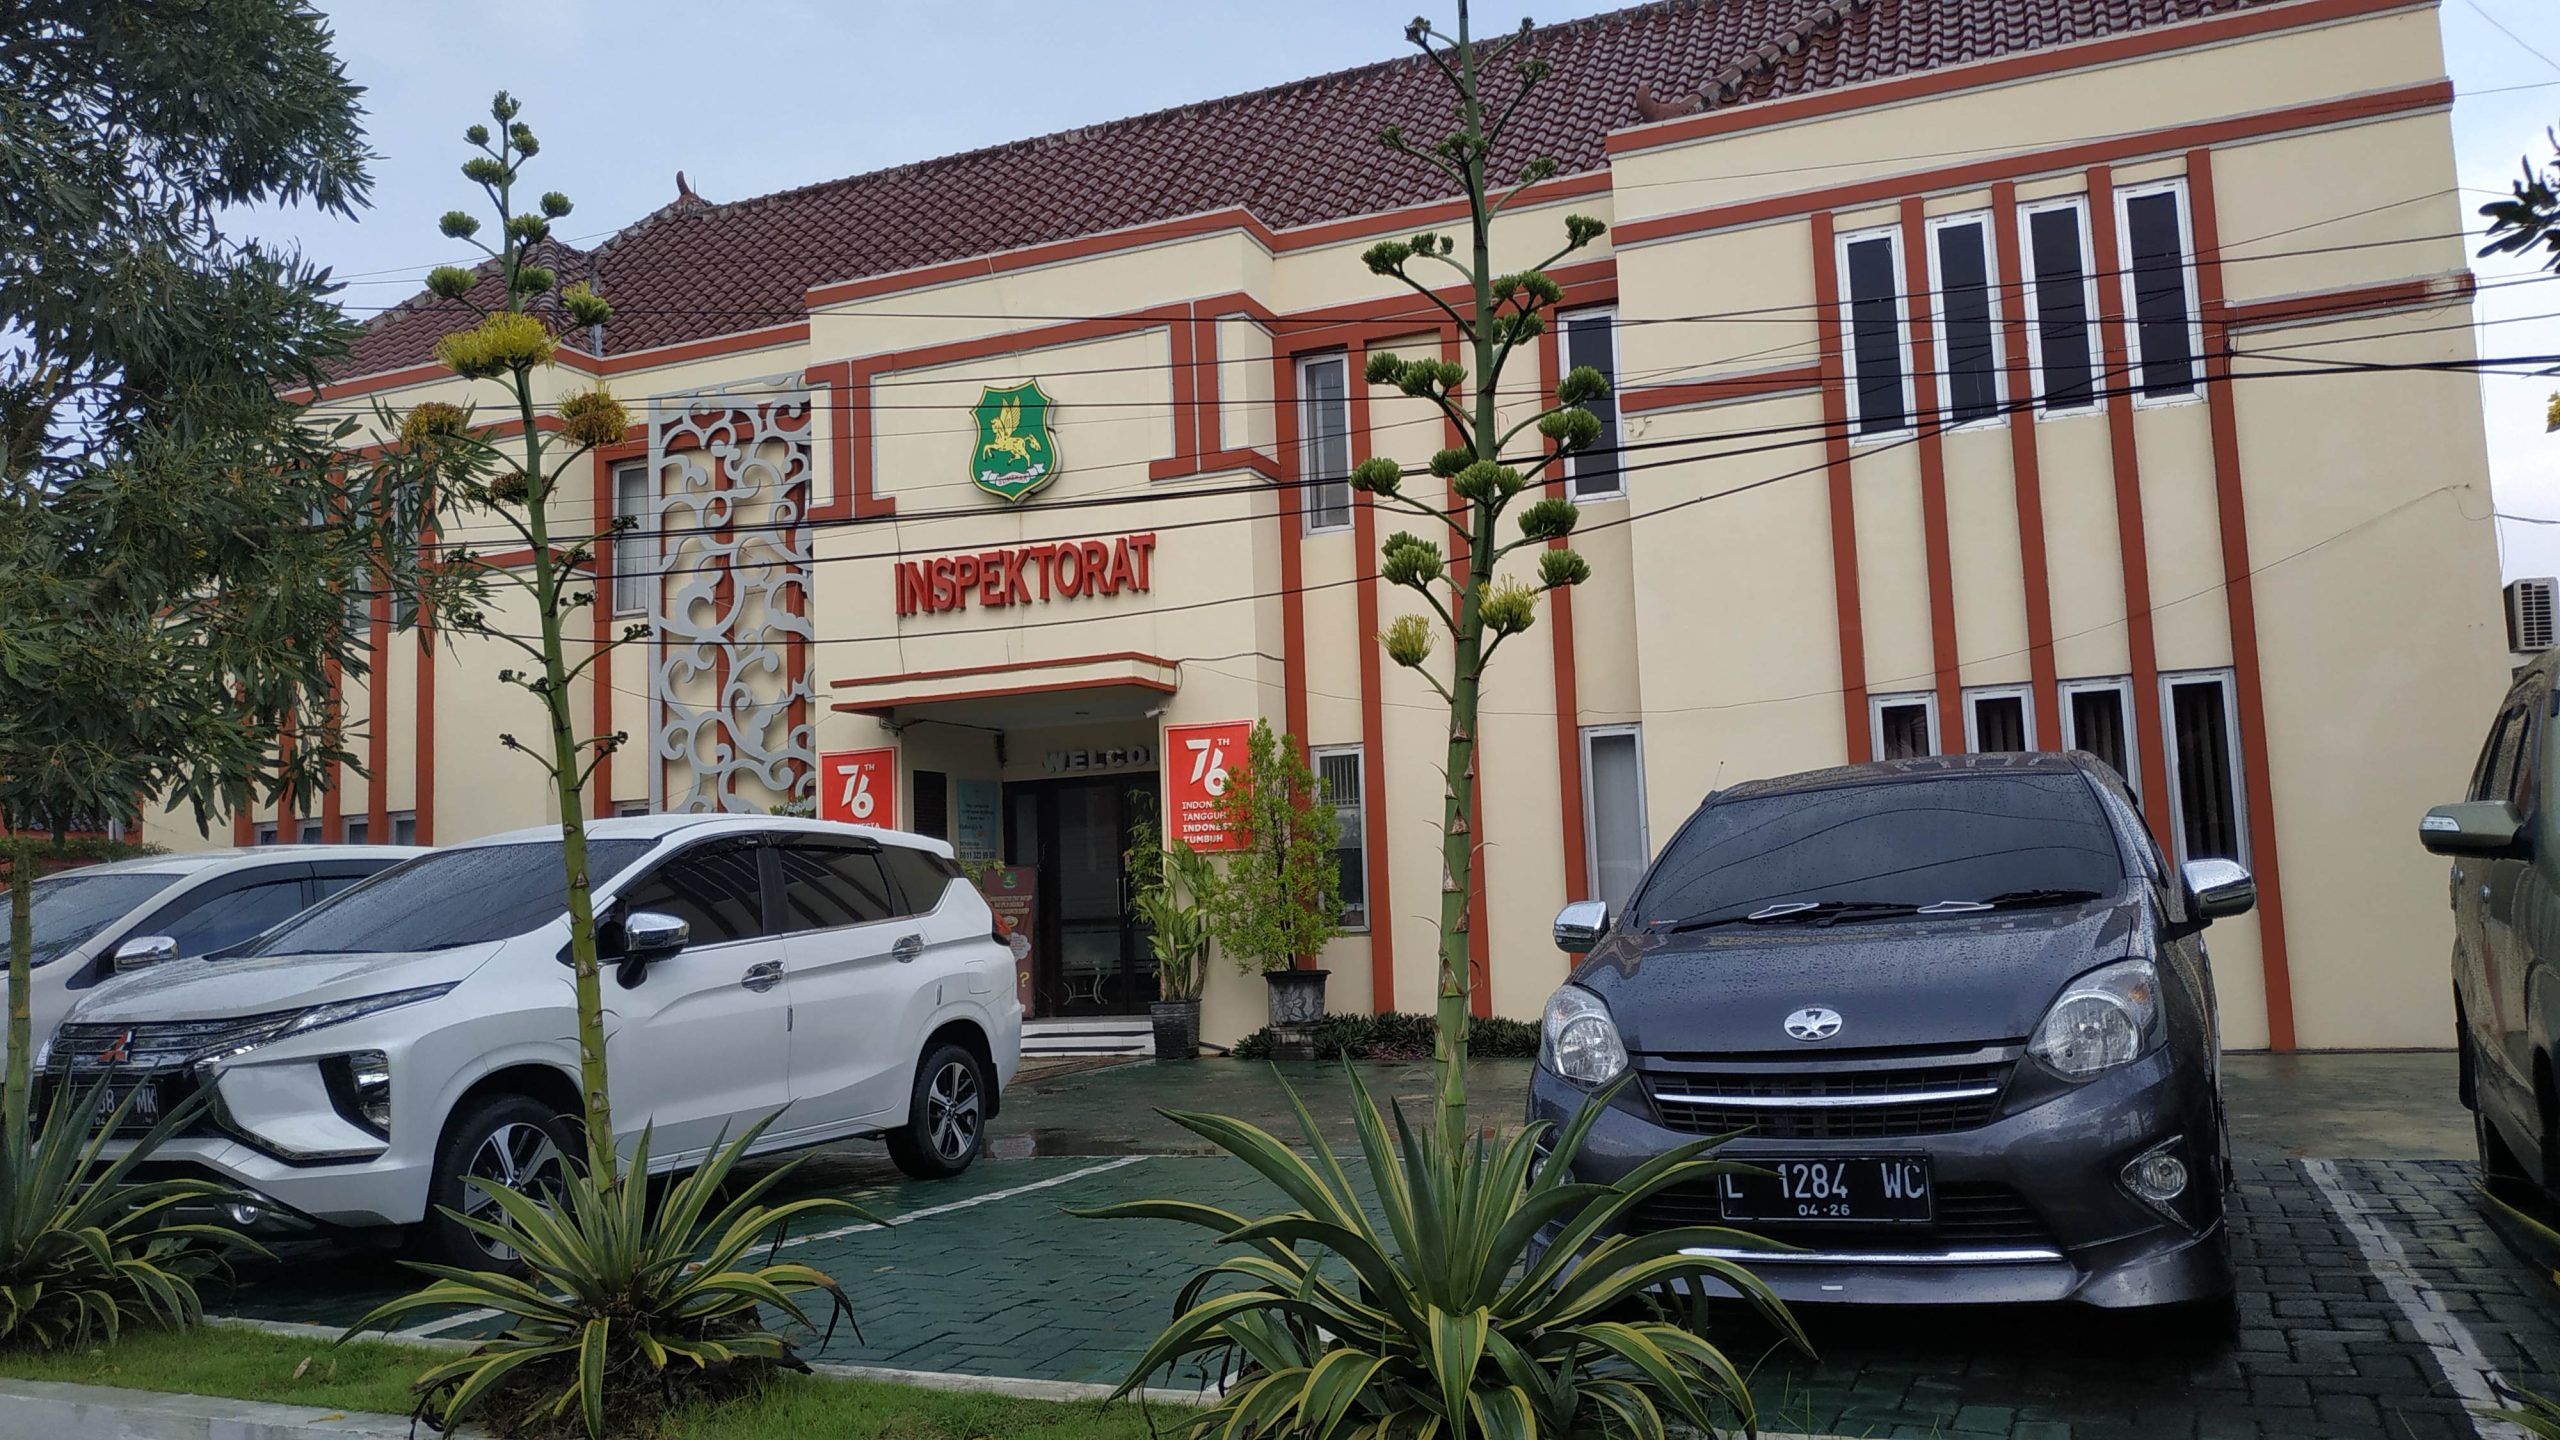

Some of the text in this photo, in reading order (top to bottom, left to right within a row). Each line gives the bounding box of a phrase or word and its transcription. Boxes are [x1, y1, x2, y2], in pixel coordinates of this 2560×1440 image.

[895, 532, 1156, 616] INSPEKTORAT
[1182, 800, 1230, 809] INDON
[1183, 811, 1227, 822] TANGGUH
[1182, 822, 1236, 833] INDONES
[1184, 834, 1223, 844] TUMBUH
[136, 1087, 157, 1113] MK
[1726, 1163, 1924, 1199] L 1284 WC
